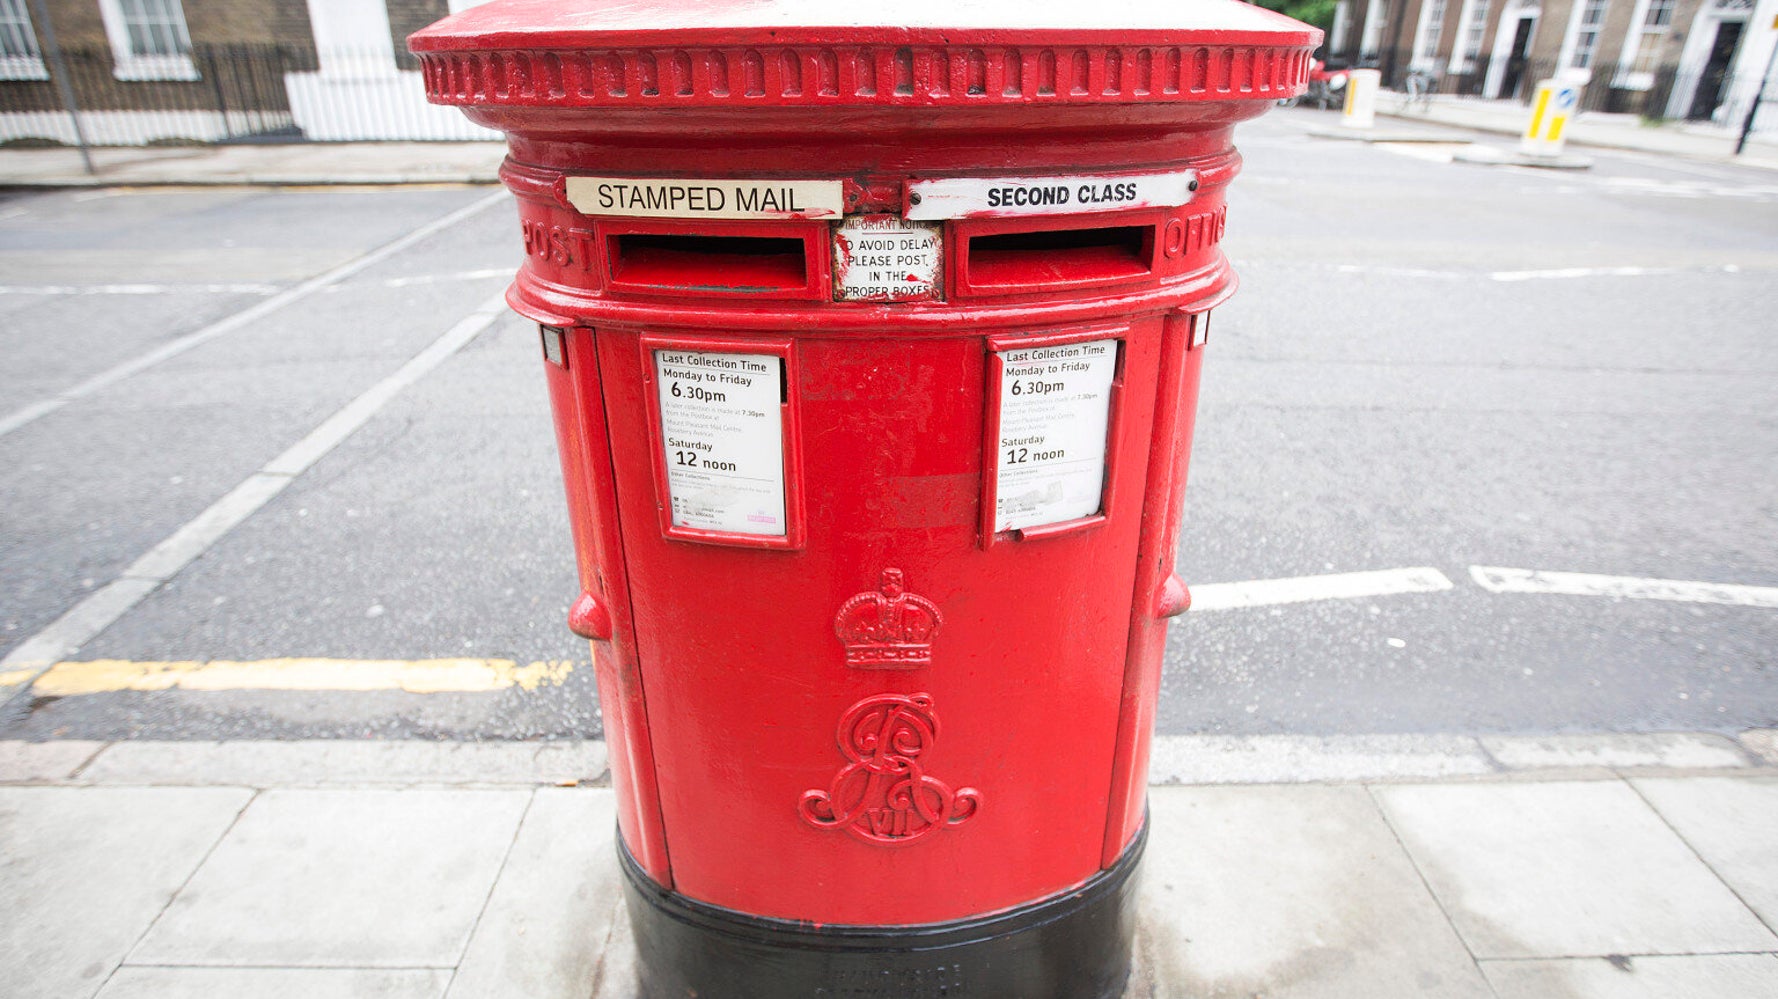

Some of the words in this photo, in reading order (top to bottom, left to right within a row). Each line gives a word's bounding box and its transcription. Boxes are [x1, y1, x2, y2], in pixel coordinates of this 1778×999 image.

[598, 184, 726, 211] STAMPED
[736, 187, 805, 213] MAIL
[987, 185, 1070, 208] SECOND
[1077, 182, 1137, 204] CLASS
[521, 218, 595, 271] POST
[858, 240, 895, 251] AVOID
[900, 238, 935, 251] DELAY
[847, 255, 892, 267] PLEASE
[869, 271, 881, 282] IN
[886, 270, 907, 282] THE
[845, 286, 889, 298] PROPER
[893, 285, 930, 297] BOXES
[1007, 353, 1028, 361] Last
[1032, 348, 1078, 359] Collection
[1083, 346, 1104, 354] Time
[662, 352, 684, 364] Last
[687, 355, 736, 368] Collection
[740, 360, 766, 372] Time
[1007, 367, 1044, 376] Monday
[1062, 362, 1088, 371] Friday
[664, 368, 702, 382] Monday
[720, 374, 751, 387] Friday
[671, 382, 725, 403] 6.30pm
[1012, 380, 1064, 395] 6.30pm
[669, 438, 712, 452] Saturday
[1002, 437, 1044, 447] Saturday
[676, 451, 697, 467] 12
[703, 460, 735, 471] noon
[1008, 448, 1027, 464] 12
[1034, 450, 1064, 461] noon
